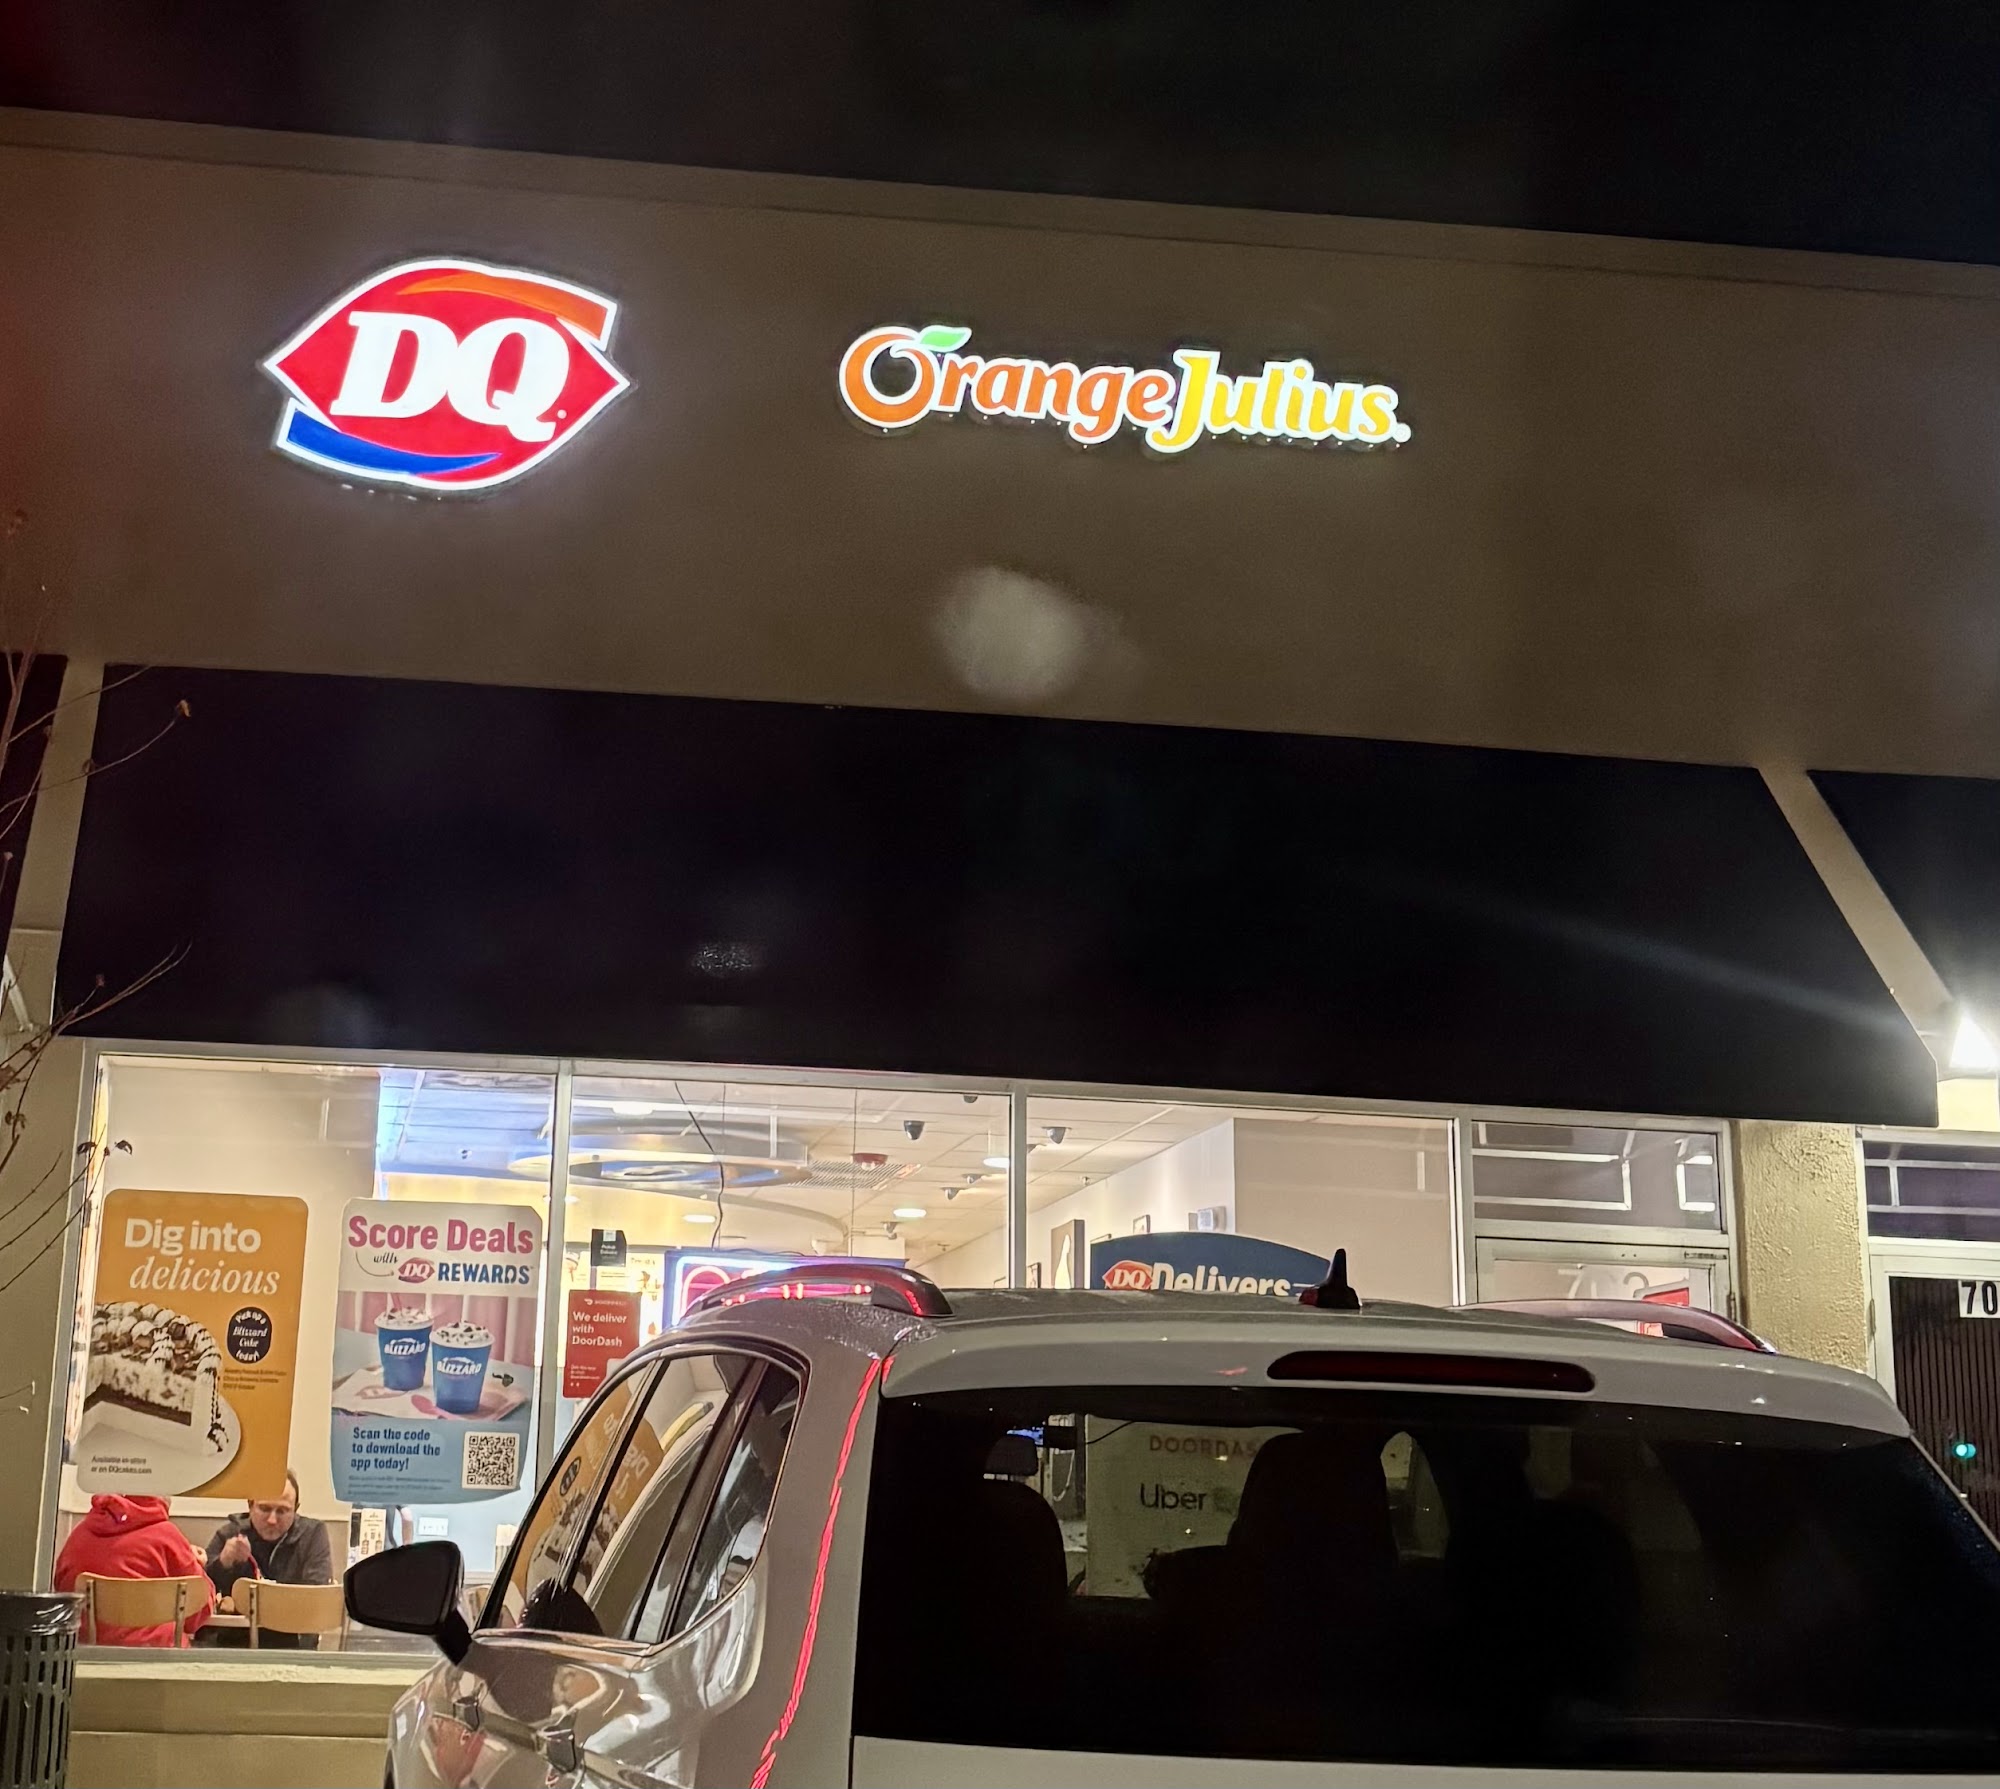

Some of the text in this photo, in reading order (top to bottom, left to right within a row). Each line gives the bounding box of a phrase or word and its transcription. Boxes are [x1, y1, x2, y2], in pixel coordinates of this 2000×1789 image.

[329, 311, 559, 442] DQ
[841, 327, 1400, 453] Orange Julius
[125, 1218, 262, 1256] Dig into
[348, 1215, 534, 1254] Score Deals
[373, 1251, 398, 1264] with
[129, 1256, 280, 1295] delicious
[403, 1262, 530, 1285] DQ REWARDS
[1112, 1268, 1149, 1288] DQ
[1961, 1281, 1998, 1315] 70
[573, 1311, 627, 1323] We deliver
[572, 1323, 595, 1334] with
[572, 1335, 622, 1348] DoorDash
[436, 1360, 482, 1376] BLIZZARD
[353, 1427, 430, 1441] Scan the code
[352, 1442, 441, 1456] to download the
[1150, 1435, 1259, 1459] DOORDAS
[350, 1457, 409, 1472] app today!
[1140, 1483, 1207, 1510] Uber
